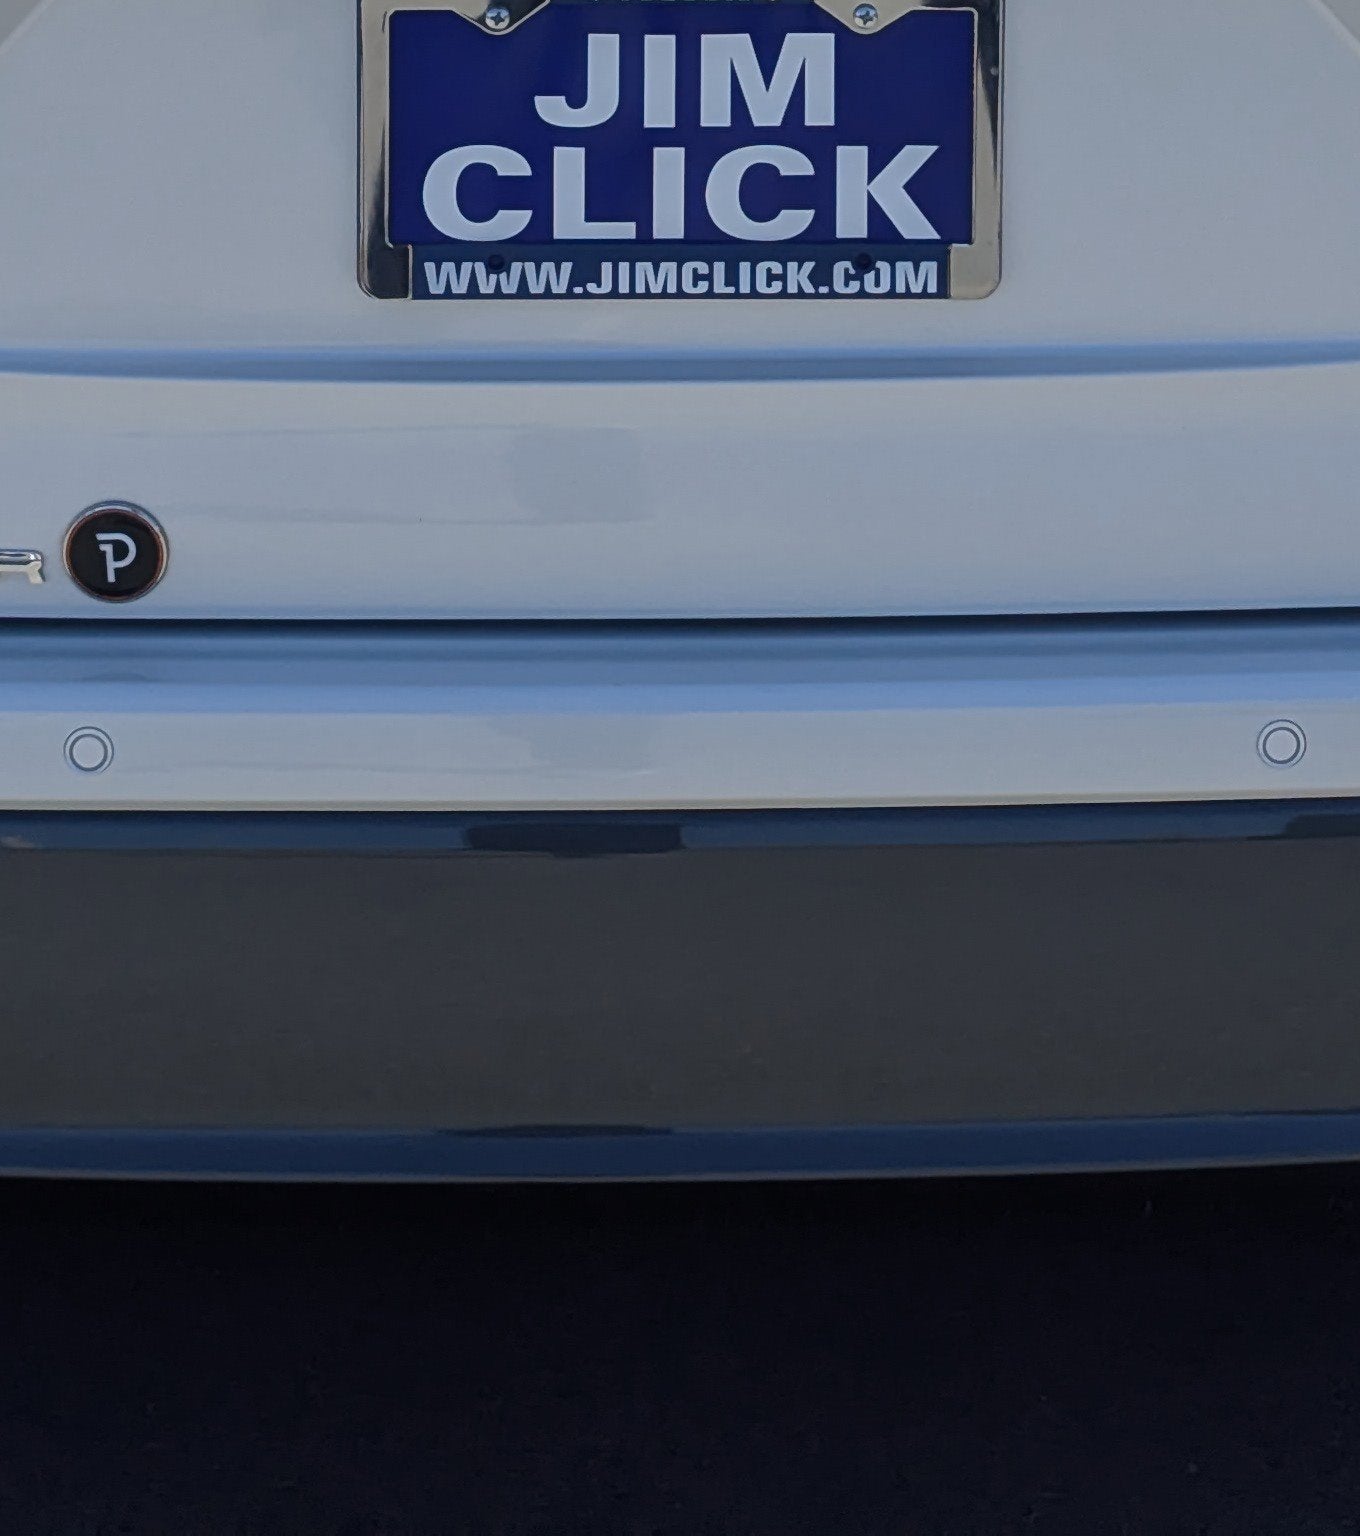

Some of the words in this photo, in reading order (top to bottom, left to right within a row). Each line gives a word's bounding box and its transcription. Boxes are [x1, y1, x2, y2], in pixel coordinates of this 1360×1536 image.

[533, 31, 836, 129] JIM
[421, 143, 941, 242] CLICK
[424, 259, 939, 296] WWW.JIMCLICK.COM
